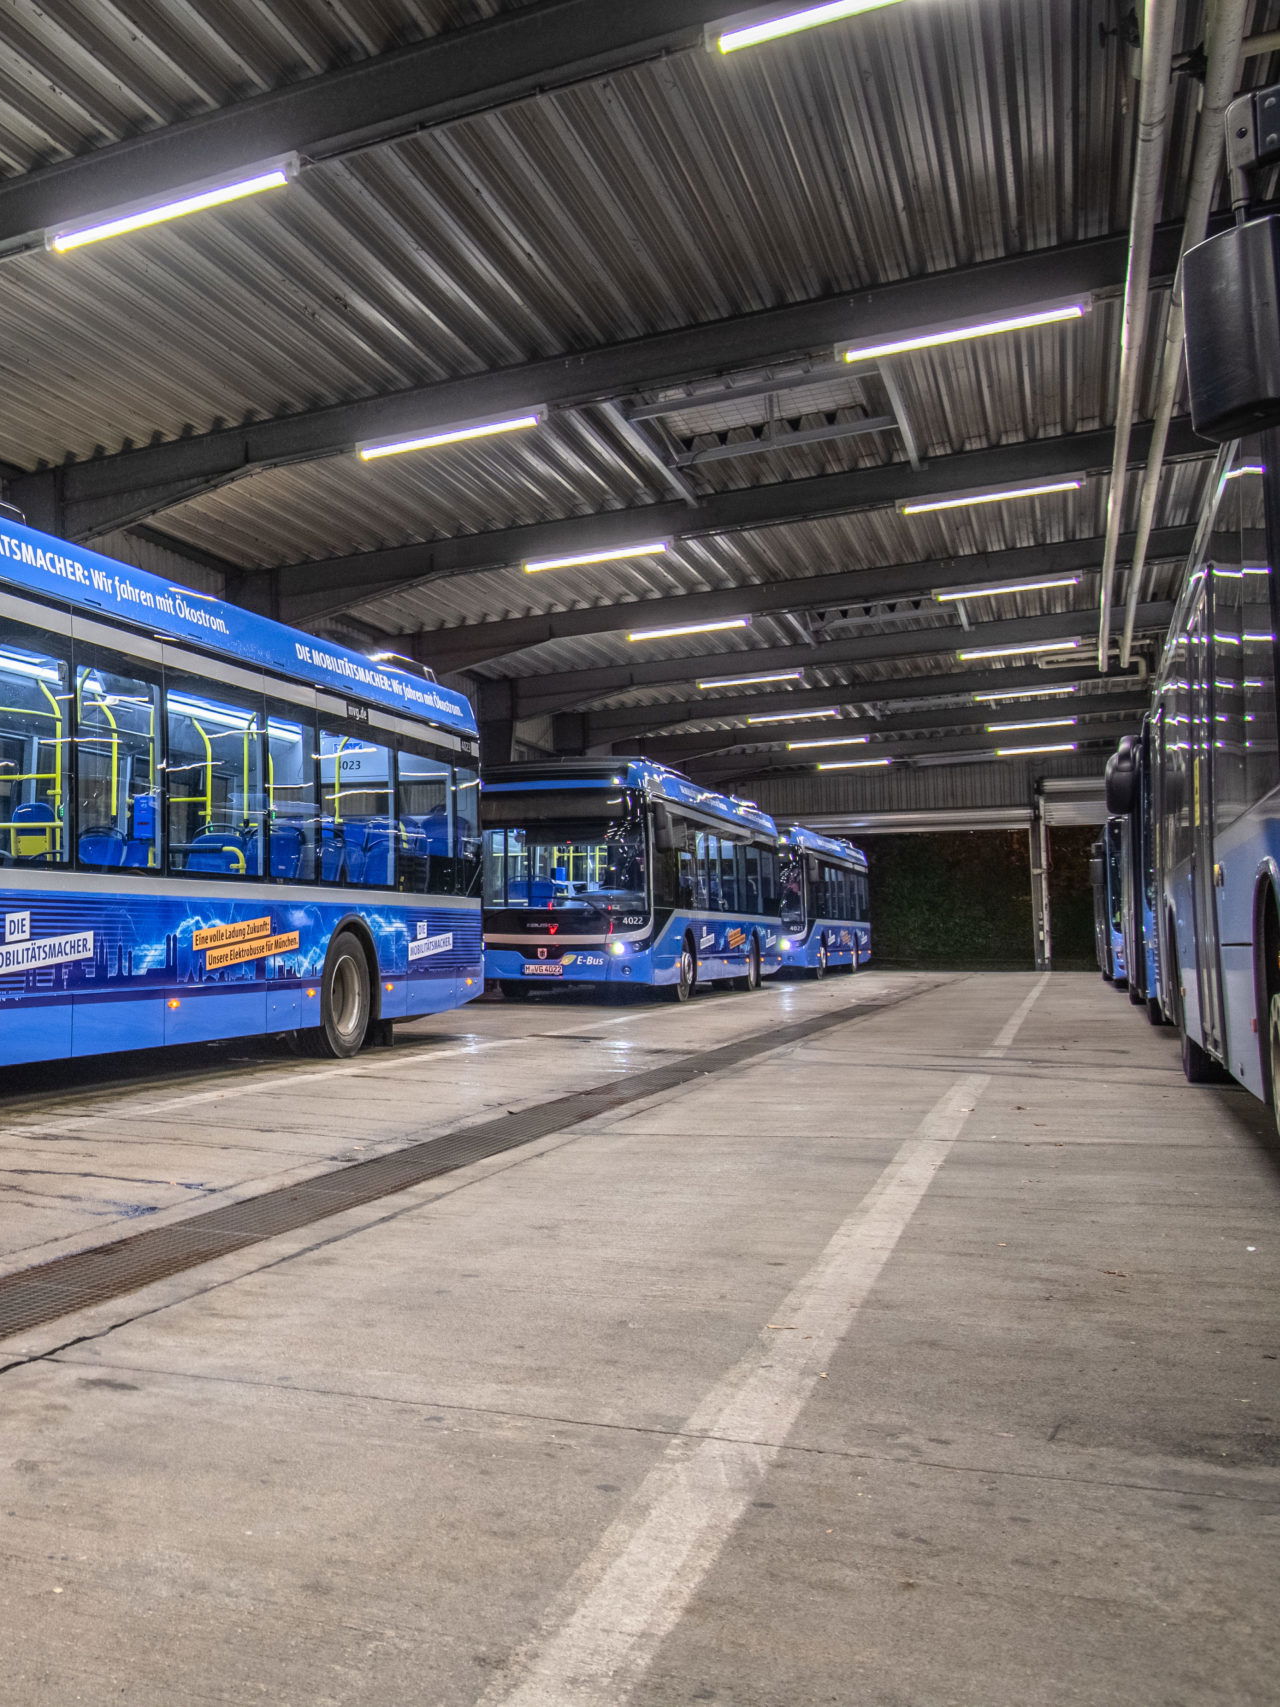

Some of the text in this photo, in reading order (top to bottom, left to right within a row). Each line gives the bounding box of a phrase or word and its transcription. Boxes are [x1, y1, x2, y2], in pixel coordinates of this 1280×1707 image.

[91, 568, 113, 595] Wir
[115, 577, 155, 607] fahren
[156, 590, 174, 613] mit
[175, 595, 230, 635] Ökostrom.
[295, 643, 312, 664] DIE
[312, 649, 392, 691] MOBILITÄTSMACHER:
[9, 918, 27, 935] DIE
[623, 916, 643, 925] 4022
[195, 933, 209, 946] Eine
[209, 930, 225, 943] volle
[225, 927, 246, 939] Ladung
[208, 953, 229, 966] Unsere
[229, 942, 265, 960] Elektrobusse
[265, 941, 274, 952] für
[577, 956, 604, 966] E-Bus
[544, 965, 562, 974] 4022
